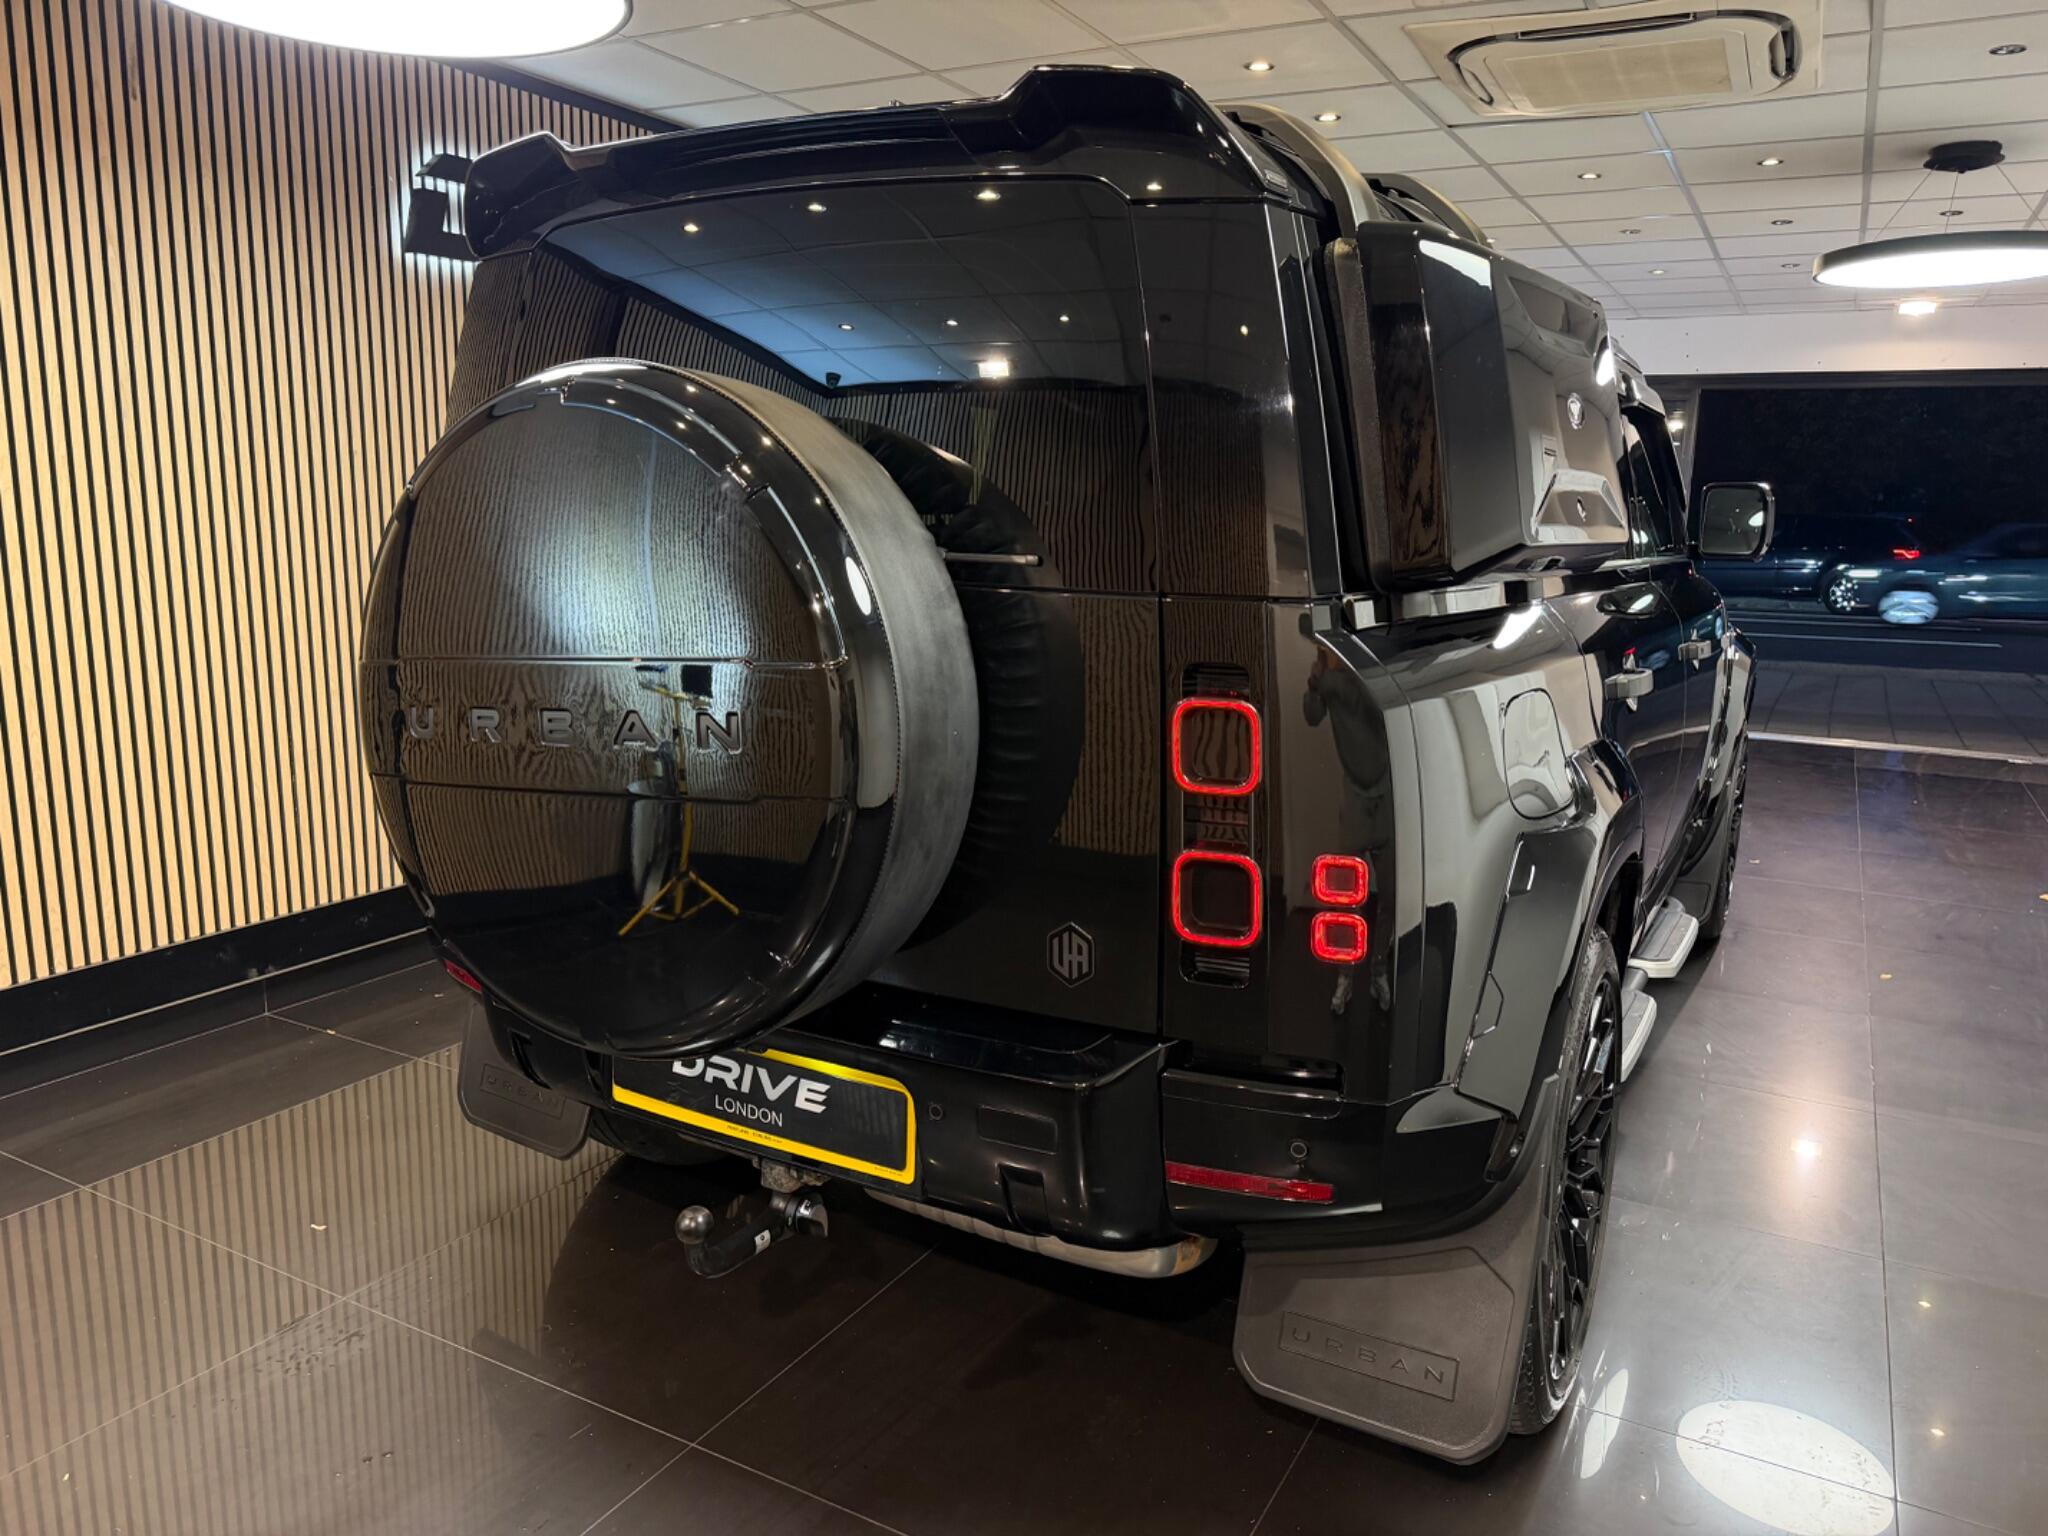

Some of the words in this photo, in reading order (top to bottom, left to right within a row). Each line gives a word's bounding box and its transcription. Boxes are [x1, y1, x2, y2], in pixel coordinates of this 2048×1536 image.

[408, 705, 743, 755] URBAN
[672, 1054, 831, 1114] DRIVE
[714, 1094, 783, 1127] LONDON
[1292, 1327, 1444, 1384] URBAN
